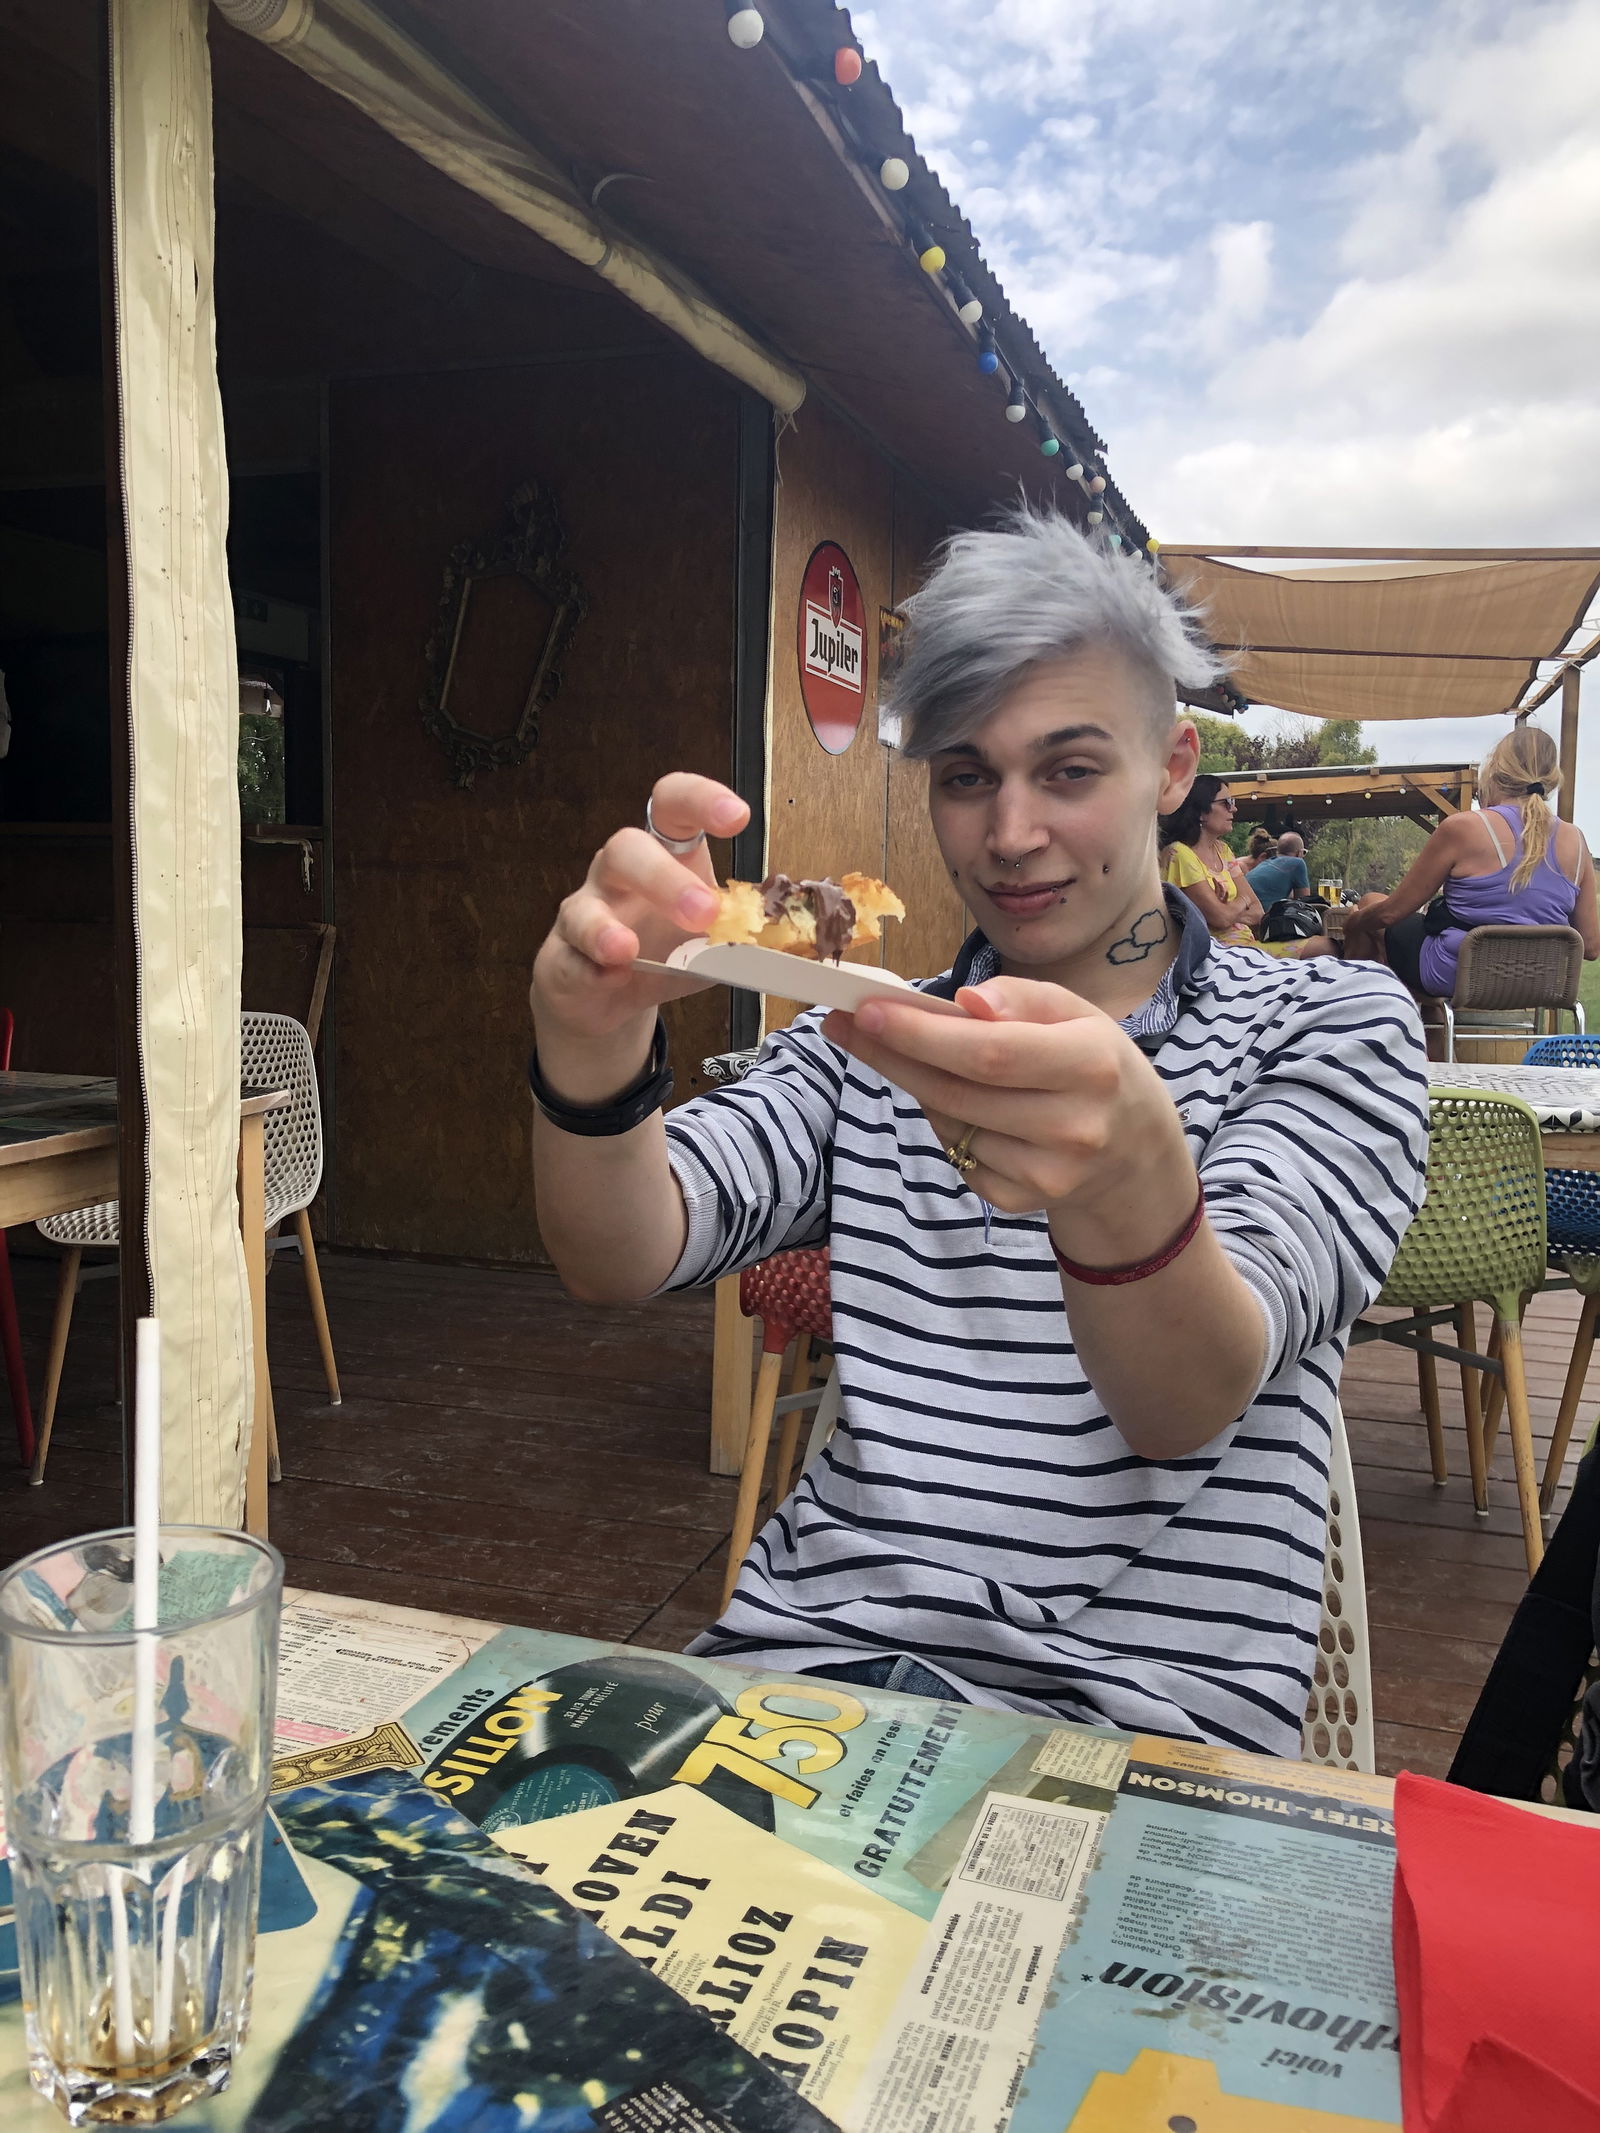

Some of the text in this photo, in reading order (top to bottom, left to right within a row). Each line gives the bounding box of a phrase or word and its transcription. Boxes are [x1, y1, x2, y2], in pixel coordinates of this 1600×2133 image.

[810, 618, 858, 676] Jupiler
[569, 1681, 620, 1730] HAUTE FIDÉLITÉ
[633, 1702, 667, 1735] pour
[423, 1687, 563, 1804] SILLON
[671, 1683, 868, 1810] 750
[837, 1805, 852, 1818] et
[848, 1767, 876, 1806] faites
[853, 1703, 964, 1878] GRATUITEMENT
[573, 1809, 677, 1924] OVEN
[1152, 1852, 1198, 1865] récepteur
[1125, 1888, 1164, 1900] absolue
[1144, 1877, 1195, 1892] récepteurs
[1144, 1885, 1170, 1894] point
[968, 1900, 983, 1919] francs
[1121, 1902, 1168, 1916] nouveaux
[1123, 1895, 1156, 1907] fidélité
[1160, 1903, 1188, 1914] haute
[620, 1871, 711, 1968] LDI
[1115, 1922, 1175, 1941] plus stable,
[1117, 1916, 1147, 1928] image
[1130, 1911, 1174, 1924] exclusifs
[920, 1913, 961, 1994] aucun versement préalable
[1110, 1938, 1161, 1956] Télévision
[955, 1998, 968, 2014] vous
[970, 1940, 990, 1979] entièrement
[1002, 1947, 1021, 1984] demandons
[1016, 1945, 1043, 2004] aucun engagement.
[943, 1995, 957, 2011] frais
[973, 1983, 985, 2002] pour
[974, 2005, 988, 2030] couvre
[811, 2039, 838, 2090] Impromptu.
[928, 2032, 956, 2088] GUILDE INTERNA-
[1260, 2047, 1343, 2079] voici
